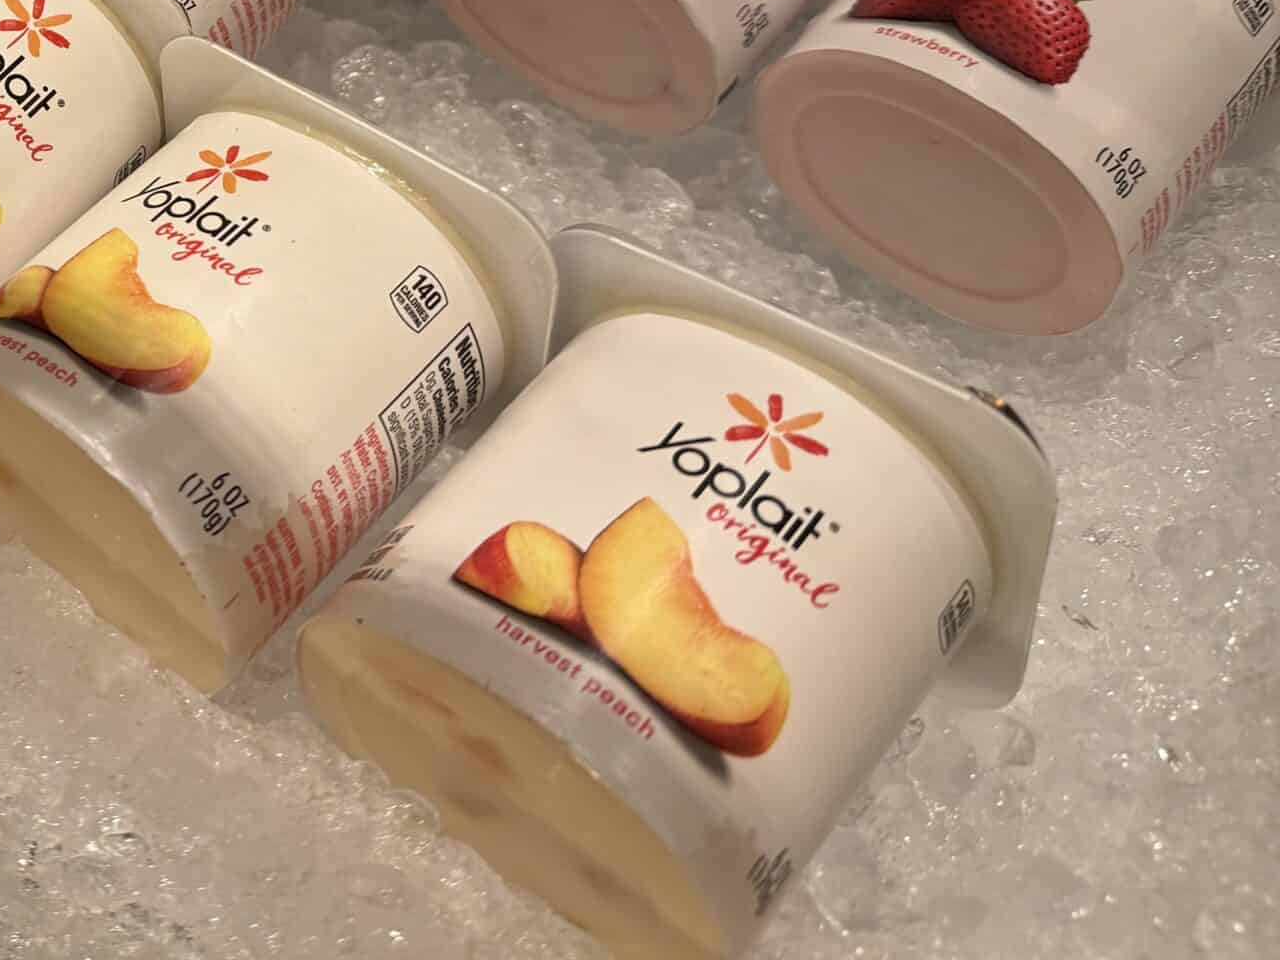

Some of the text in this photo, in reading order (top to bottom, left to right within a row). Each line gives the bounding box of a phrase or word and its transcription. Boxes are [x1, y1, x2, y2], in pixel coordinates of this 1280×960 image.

[876, 24, 979, 69] strawberry
[120, 176, 258, 247] Yoplait
[154, 221, 265, 287] original
[400, 284, 430, 323] CALORIES
[411, 273, 442, 311] 140
[23, 348, 78, 388] peach
[178, 472, 232, 537] (170g)
[211, 472, 252, 518] 6 OZ
[636, 421, 825, 551] Yoplait
[705, 501, 841, 609] original
[495, 615, 657, 741] harvest peach
